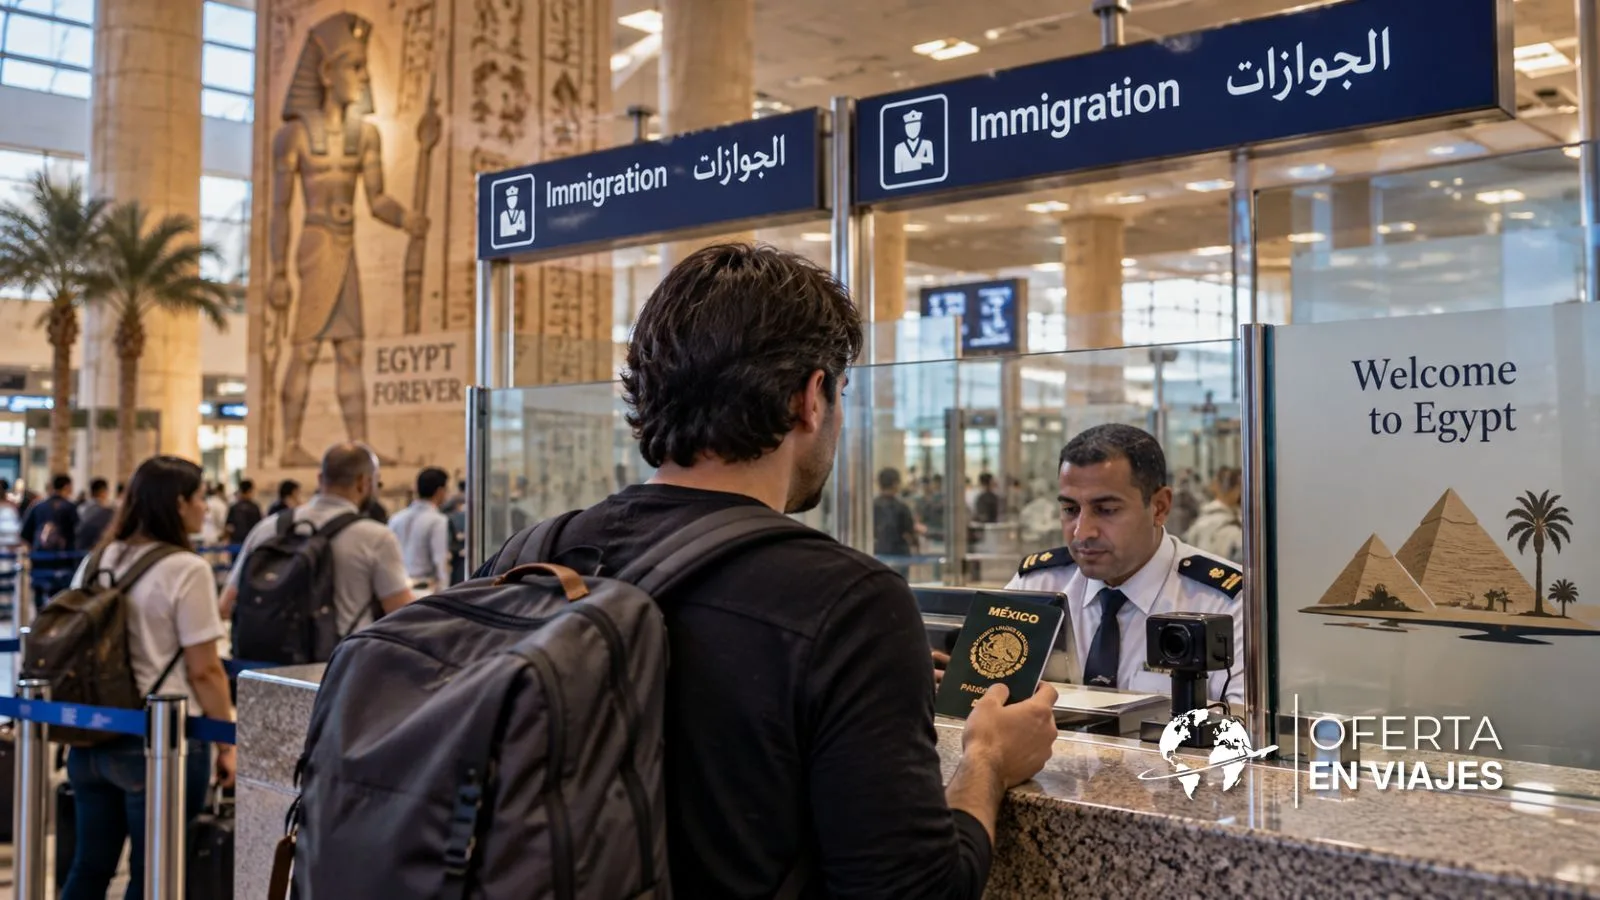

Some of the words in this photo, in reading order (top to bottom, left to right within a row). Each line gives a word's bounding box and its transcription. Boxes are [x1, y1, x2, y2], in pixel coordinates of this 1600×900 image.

[1226, 26, 1391, 101] الجوازات
[971, 77, 1180, 142] Immigration
[693, 134, 786, 185] الجوازات
[546, 163, 667, 208] Immigration
[376, 342, 456, 374] EGYPT
[1351, 355, 1517, 391] Welcome
[373, 378, 462, 406] FOREVER
[1368, 407, 1402, 435] to
[1414, 401, 1517, 443] Egypt
[988, 606, 1040, 624] MÉXICO
